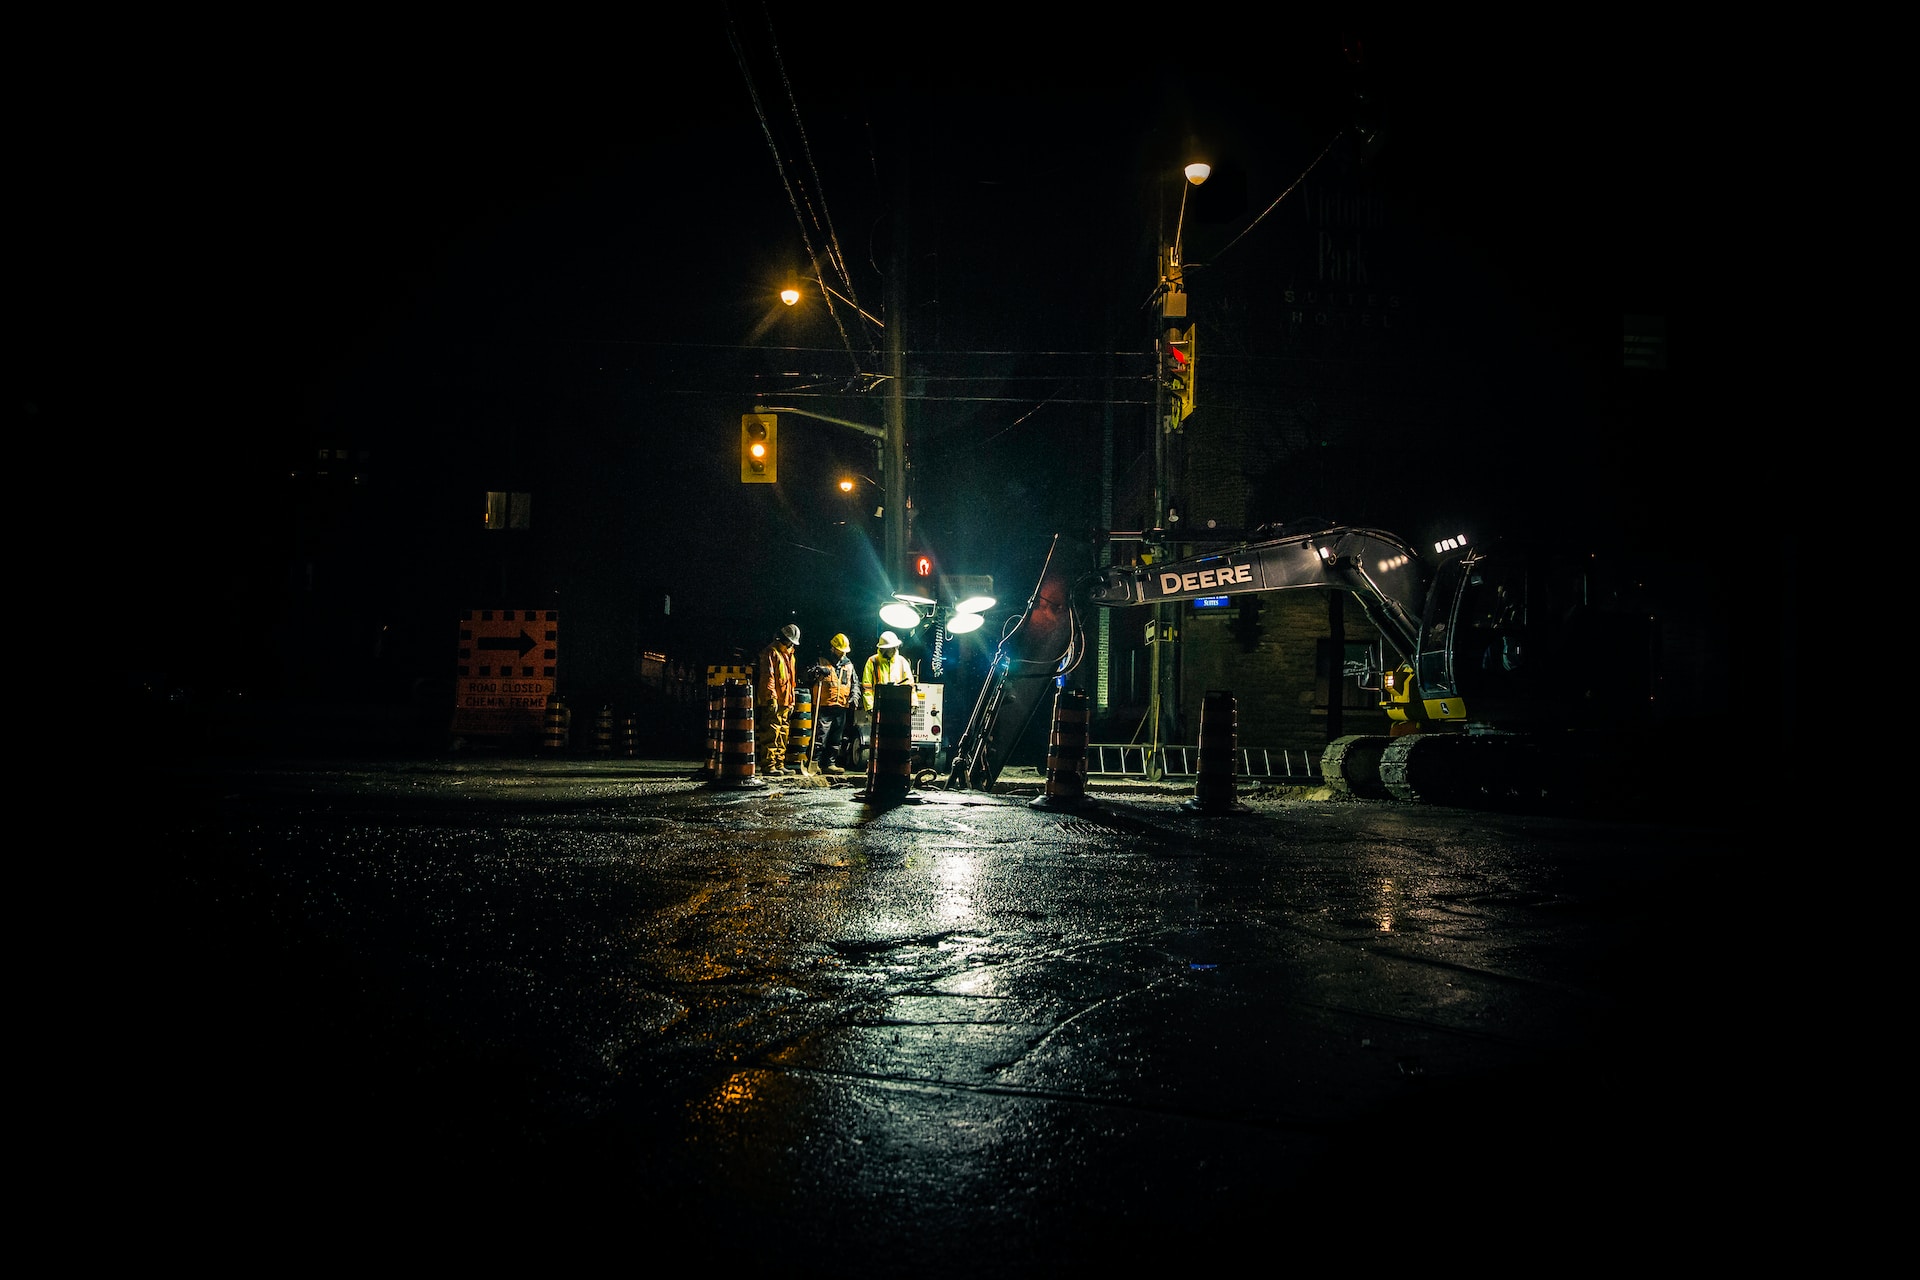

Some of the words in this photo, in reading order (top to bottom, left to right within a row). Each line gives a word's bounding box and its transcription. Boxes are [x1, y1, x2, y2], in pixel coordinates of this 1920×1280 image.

[1317, 231, 1369, 285] Park
[1284, 290, 1400, 308] SUITES
[1291, 311, 1393, 329] HOTEL
[1159, 563, 1253, 595] DEERE
[469, 683, 497, 693] ROAD
[502, 683, 542, 693] CLOSED
[465, 696, 505, 707] CHEMIN
